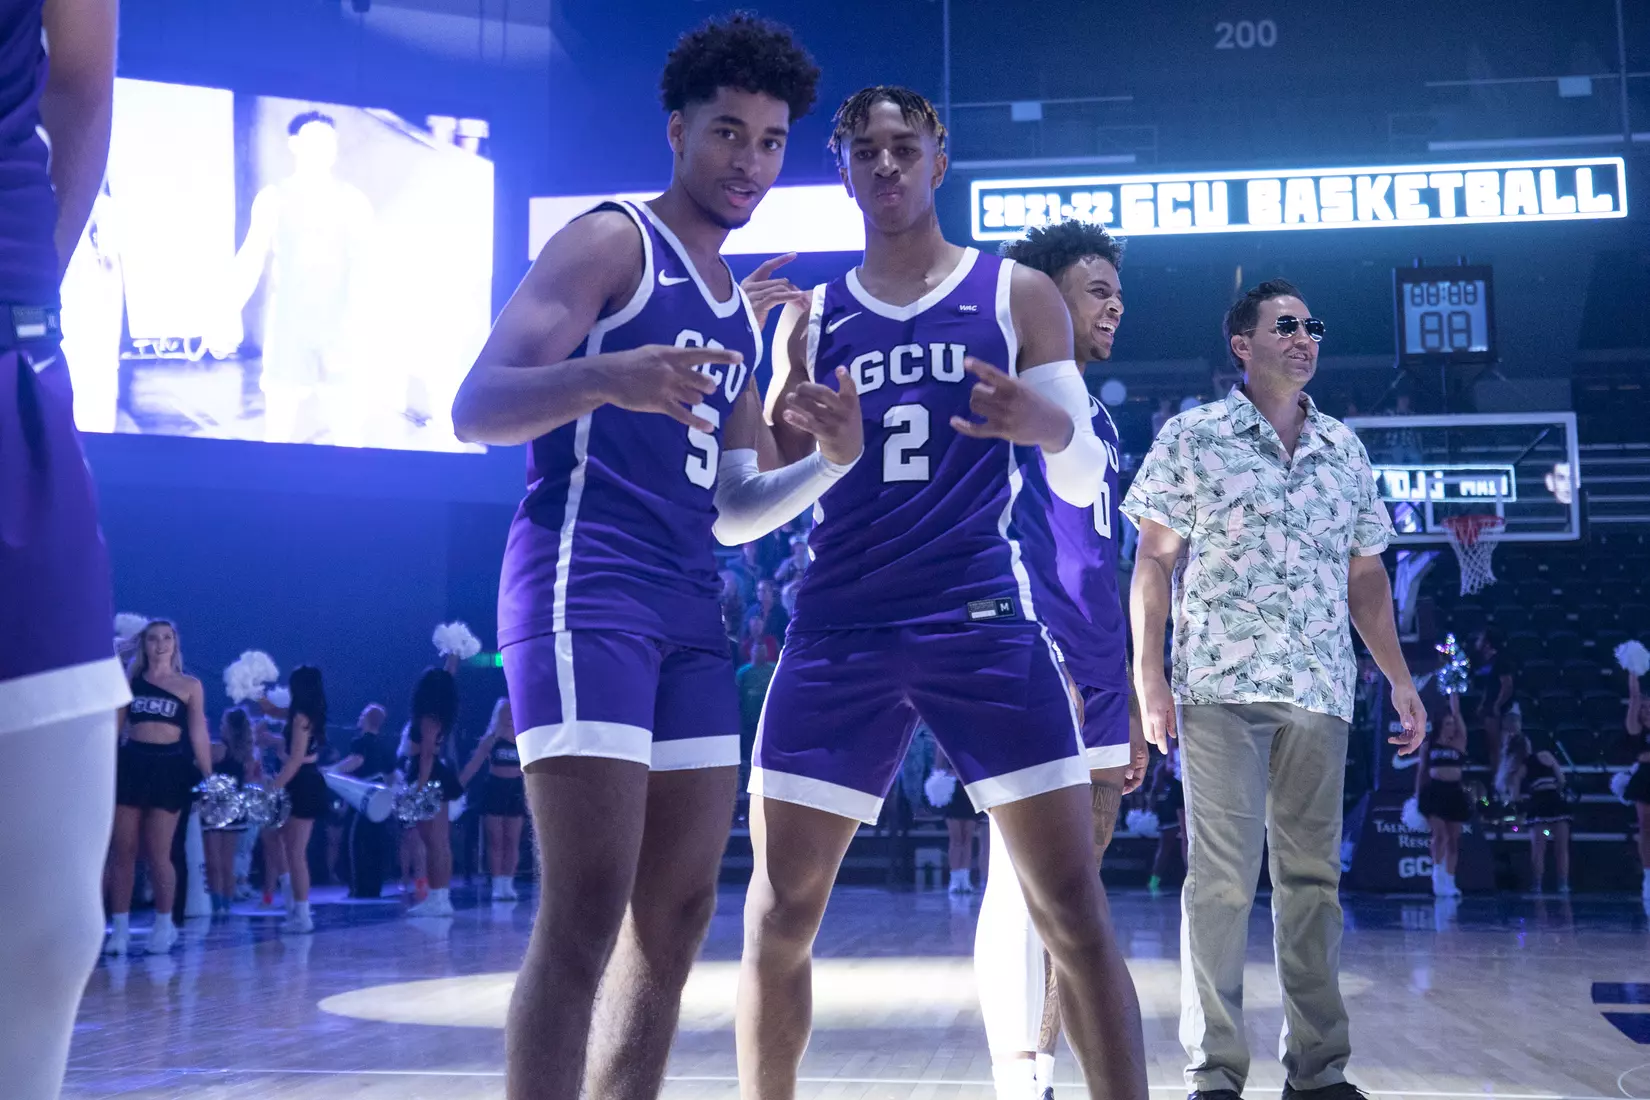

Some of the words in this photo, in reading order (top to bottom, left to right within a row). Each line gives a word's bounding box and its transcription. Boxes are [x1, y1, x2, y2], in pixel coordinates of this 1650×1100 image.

[1215, 21, 1277, 48] 200
[1120, 180, 1229, 230] GCU
[1246, 167, 1613, 226] BASKETBALL
[850, 343, 967, 396] GCU
[685, 402, 720, 490] 5
[883, 404, 930, 483] 2
[1000, 602, 1010, 612] M
[1373, 820, 1432, 834] TALK
[1399, 834, 1434, 849] RESO
[1398, 856, 1433, 879] GC
